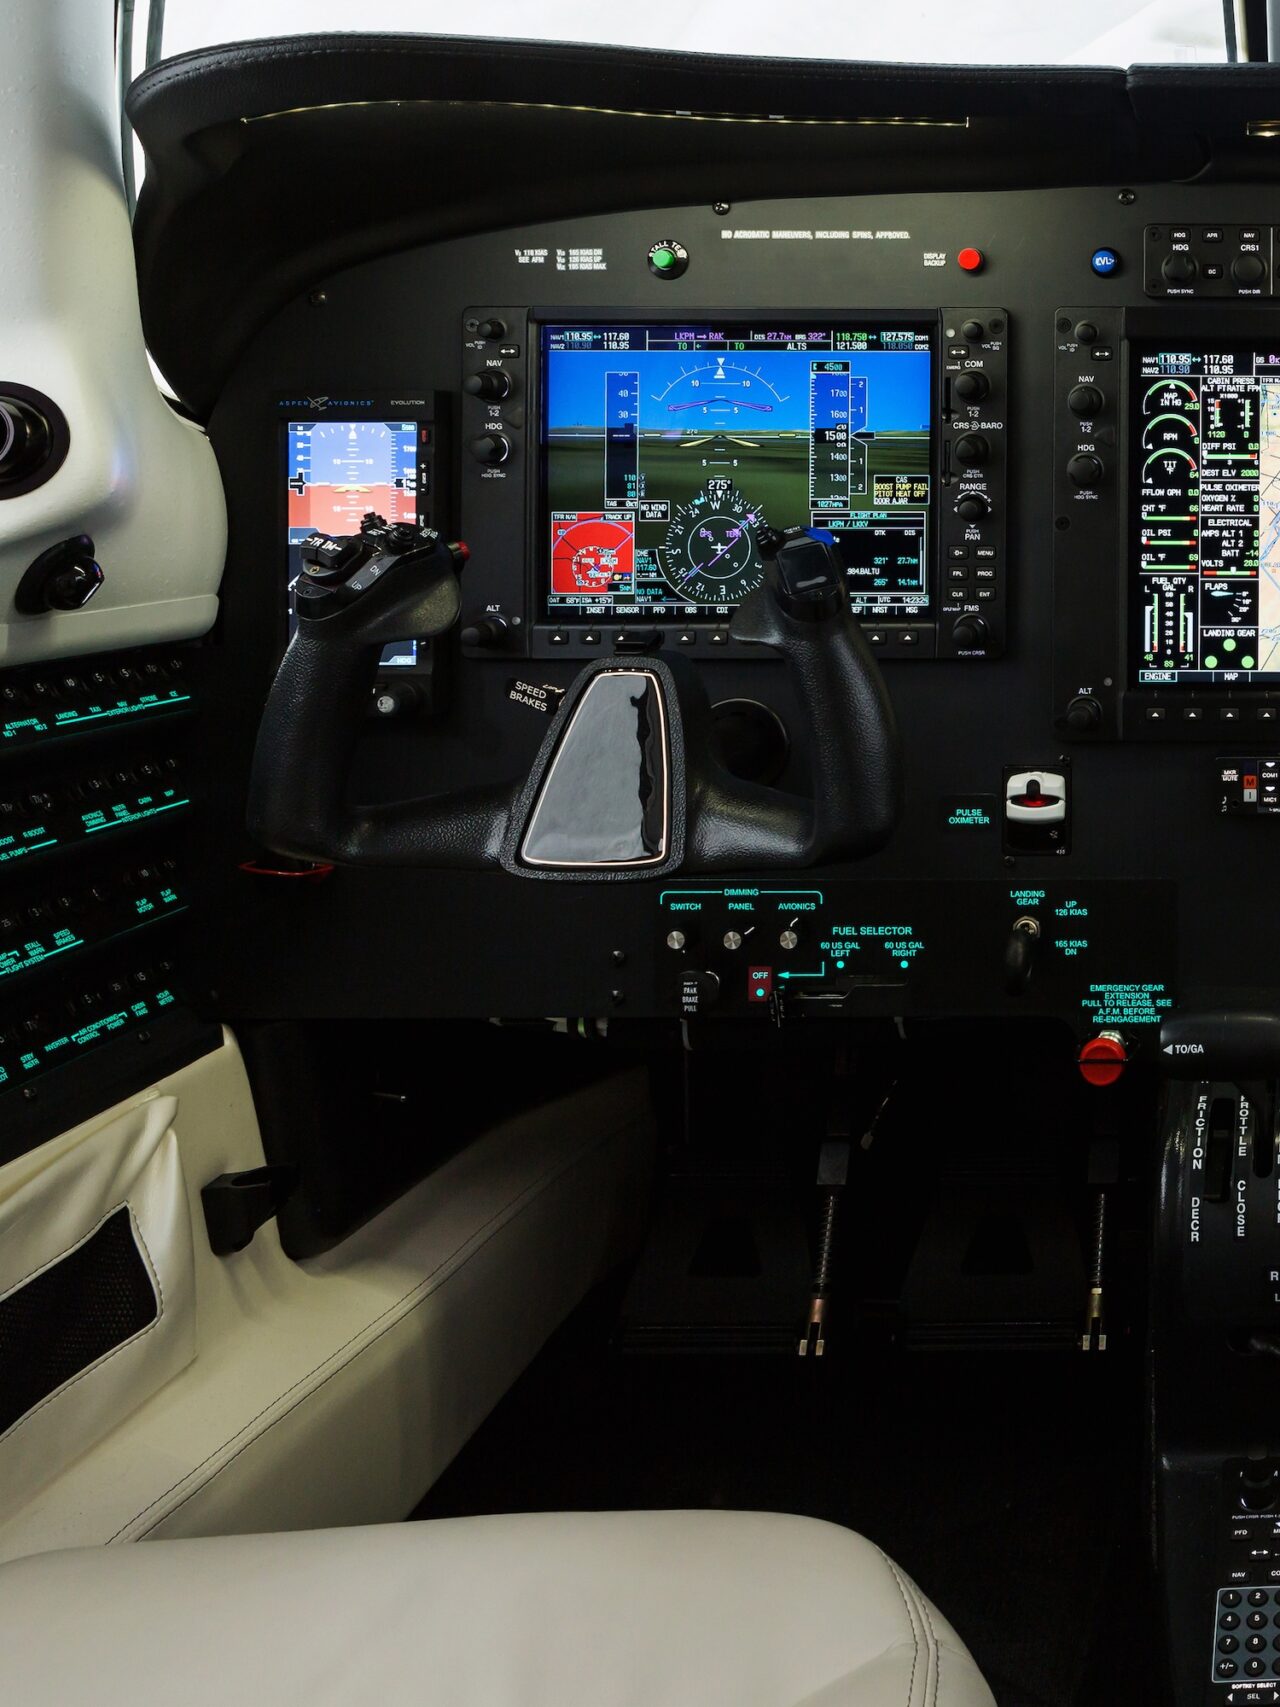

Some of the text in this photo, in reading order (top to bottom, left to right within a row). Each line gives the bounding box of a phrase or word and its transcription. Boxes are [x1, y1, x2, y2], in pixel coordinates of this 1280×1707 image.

[816, 231, 849, 239] INCLUDING
[836, 333, 867, 341] 118.750
[883, 333, 913, 341] 127.575
[787, 342, 807, 350] ALTS
[1203, 355, 1233, 363] 117.60
[965, 360, 983, 368] COM
[953, 422, 969, 430] CRS
[981, 422, 1002, 430] BARO
[708, 480, 730, 490] 275°
[516, 681, 547, 699] SPEED
[510, 691, 548, 712] BRAKES
[54, 929, 70, 939] SPEED
[833, 927, 912, 935] FUEL SELECTOR
[56, 935, 75, 946] BRAKES
[1116, 1000, 1154, 1008] RELEASE,
[1175, 1044, 1204, 1054] TO/GA
[1191, 1096, 1207, 1242] FRICTION DECR
[1237, 1180, 1246, 1236] CLOSE
